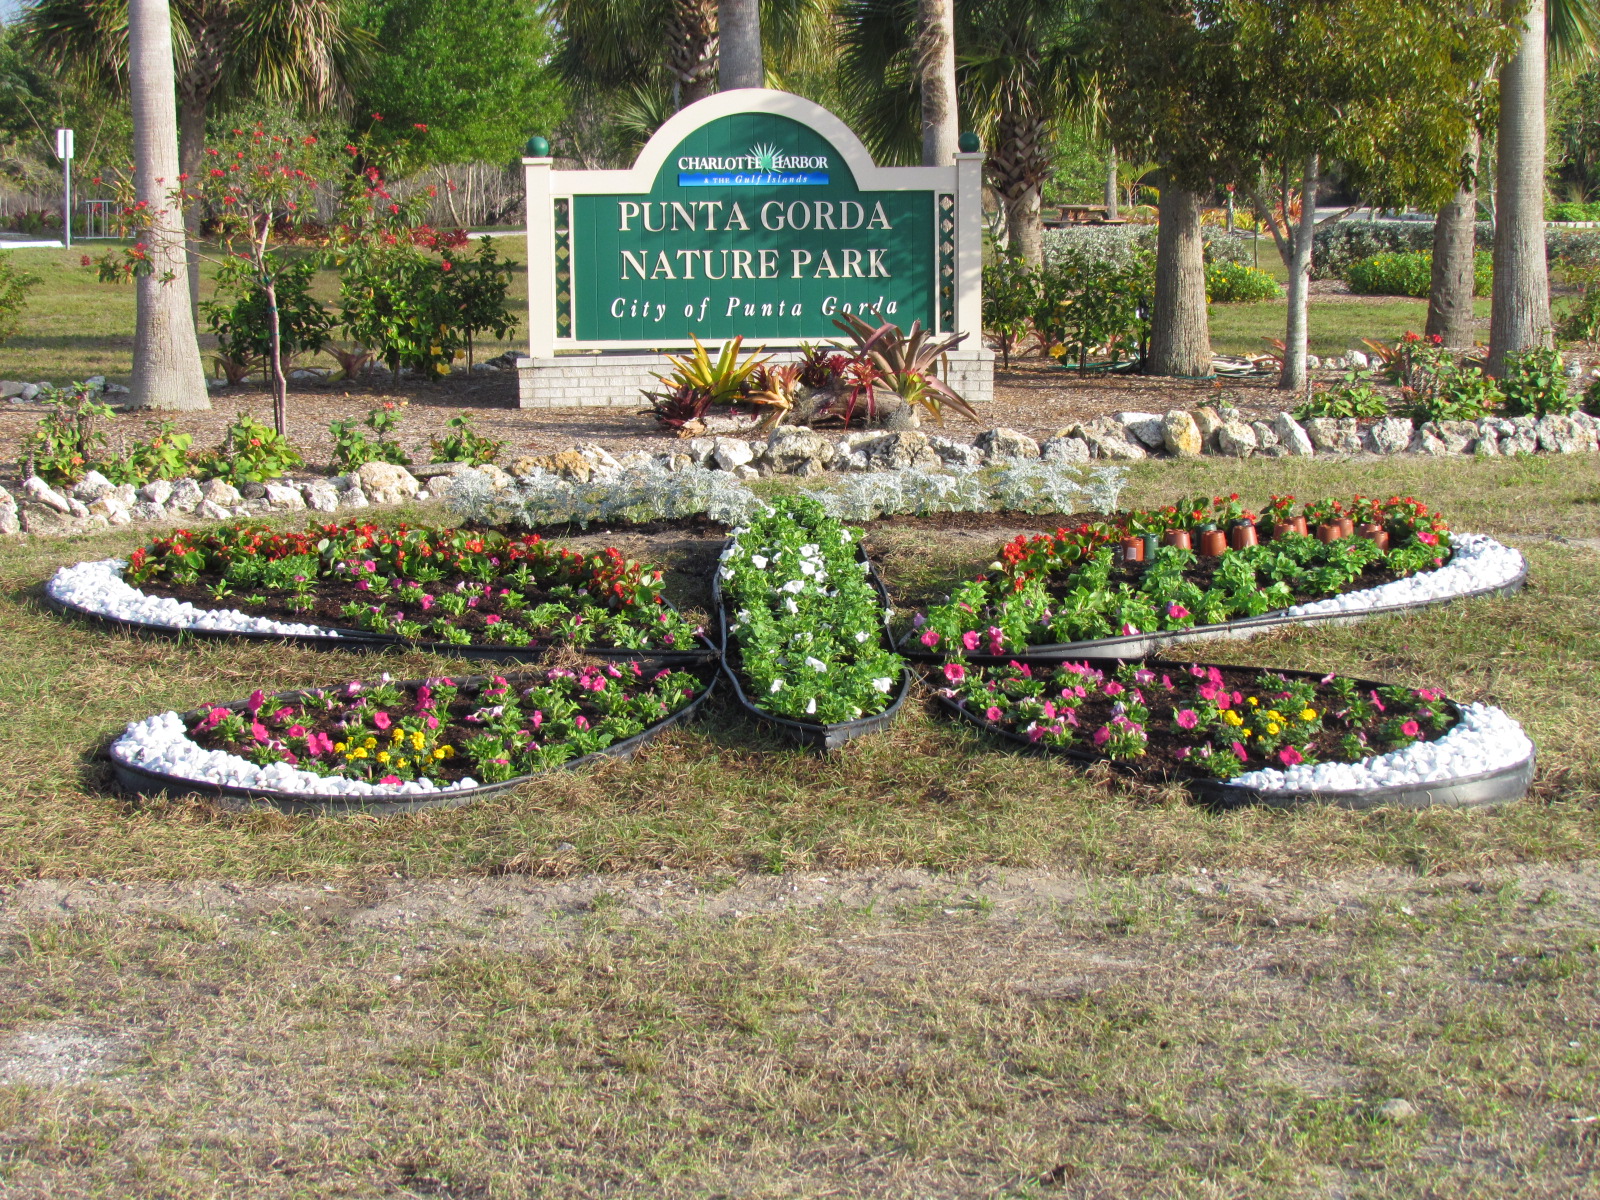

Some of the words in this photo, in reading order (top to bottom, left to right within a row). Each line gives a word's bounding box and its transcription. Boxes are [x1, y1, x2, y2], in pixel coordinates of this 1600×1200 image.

[678, 156, 762, 170] CHARLOTTE
[772, 155, 829, 169] HARBOR
[735, 175, 762, 185] Gulf
[766, 174, 808, 184] Islands
[617, 201, 750, 232] PUNTA
[760, 200, 893, 231] GORDA
[620, 249, 780, 280] NATURE
[790, 248, 892, 279] PARK
[610, 297, 666, 322] City
[684, 297, 710, 322] of
[725, 297, 802, 318] Punta
[821, 296, 898, 316] Gorda
